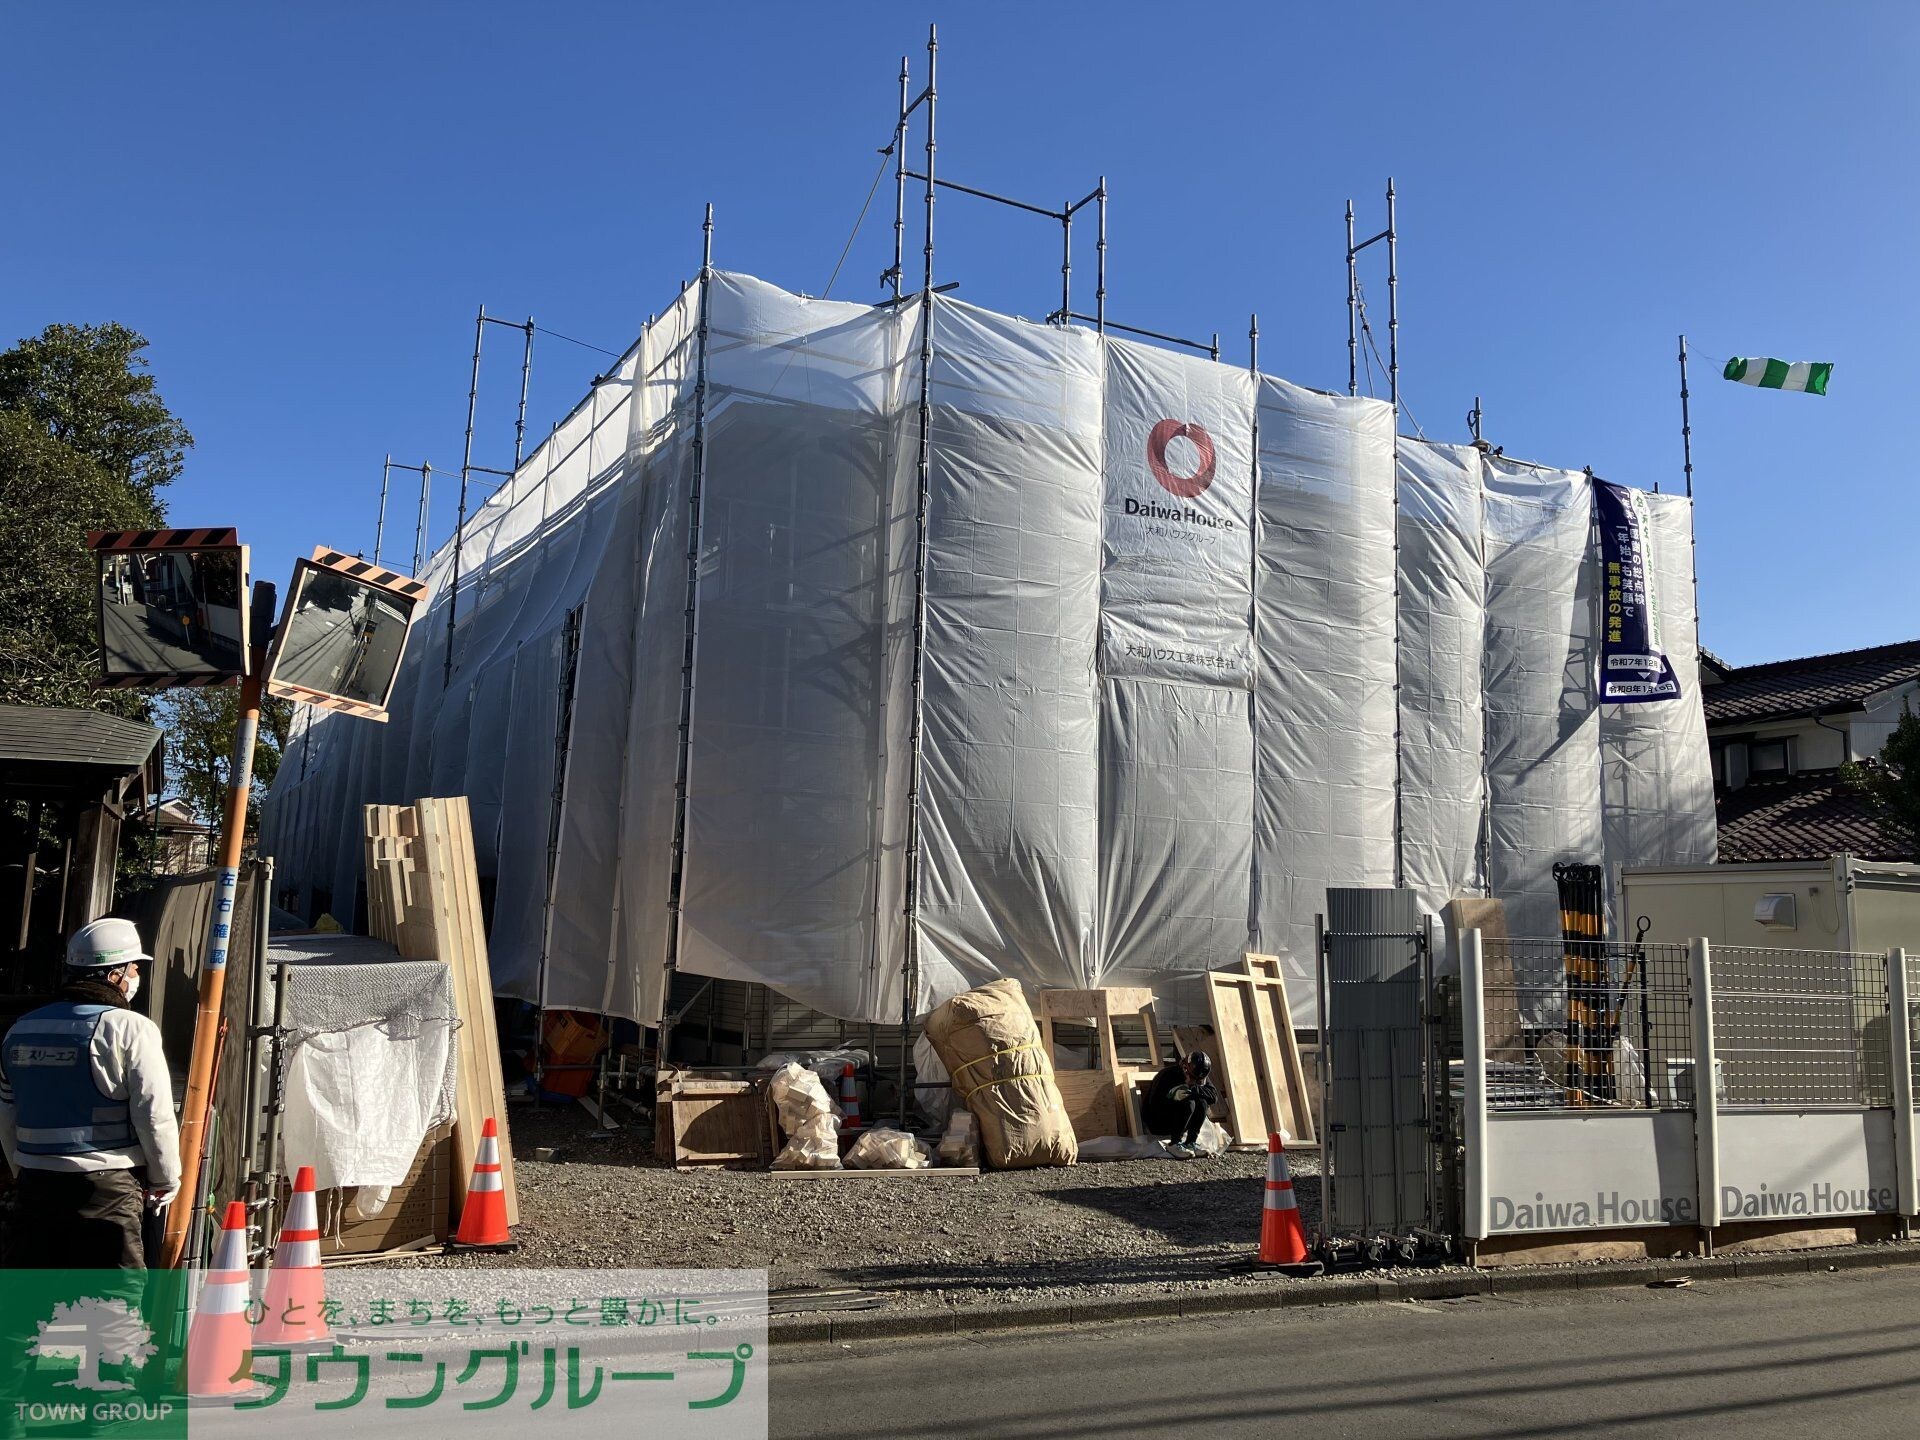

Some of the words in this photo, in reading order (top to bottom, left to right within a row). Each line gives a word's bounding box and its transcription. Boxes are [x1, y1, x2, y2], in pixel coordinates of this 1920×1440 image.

[1125, 497, 1182, 522] Daiwa
[1183, 506, 1234, 532] House
[1608, 561, 1622, 643] 無事故の発進
[1125, 644, 1236, 670] 大和ハウス工業株式会社
[210, 871, 236, 964] 左右確認
[29, 1049, 77, 1062] スリーエス
[1489, 1192, 1590, 1231] Daiwa
[1598, 1191, 1692, 1225] House
[1720, 1182, 1807, 1217] Daiwa
[1812, 1182, 1892, 1213] House
